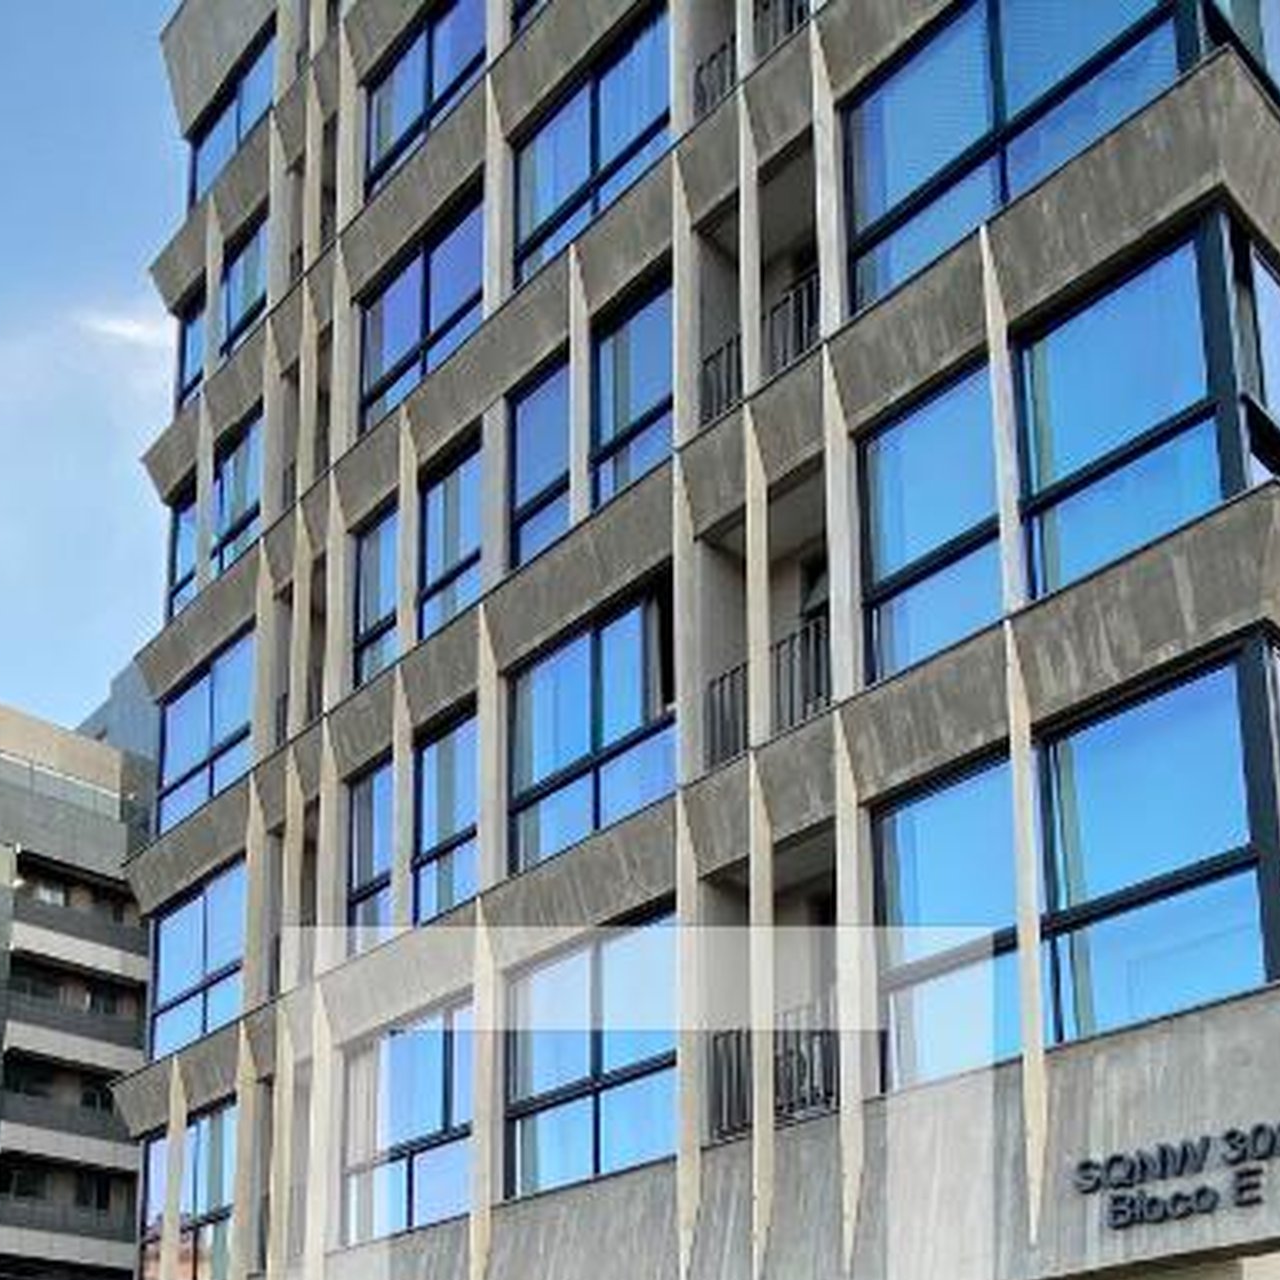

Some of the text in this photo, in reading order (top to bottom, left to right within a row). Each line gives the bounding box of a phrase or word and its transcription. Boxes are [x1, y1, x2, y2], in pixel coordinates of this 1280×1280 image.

[1074, 1135, 1211, 1194] SQNW
[1107, 1168, 1264, 1230] Bloco E
